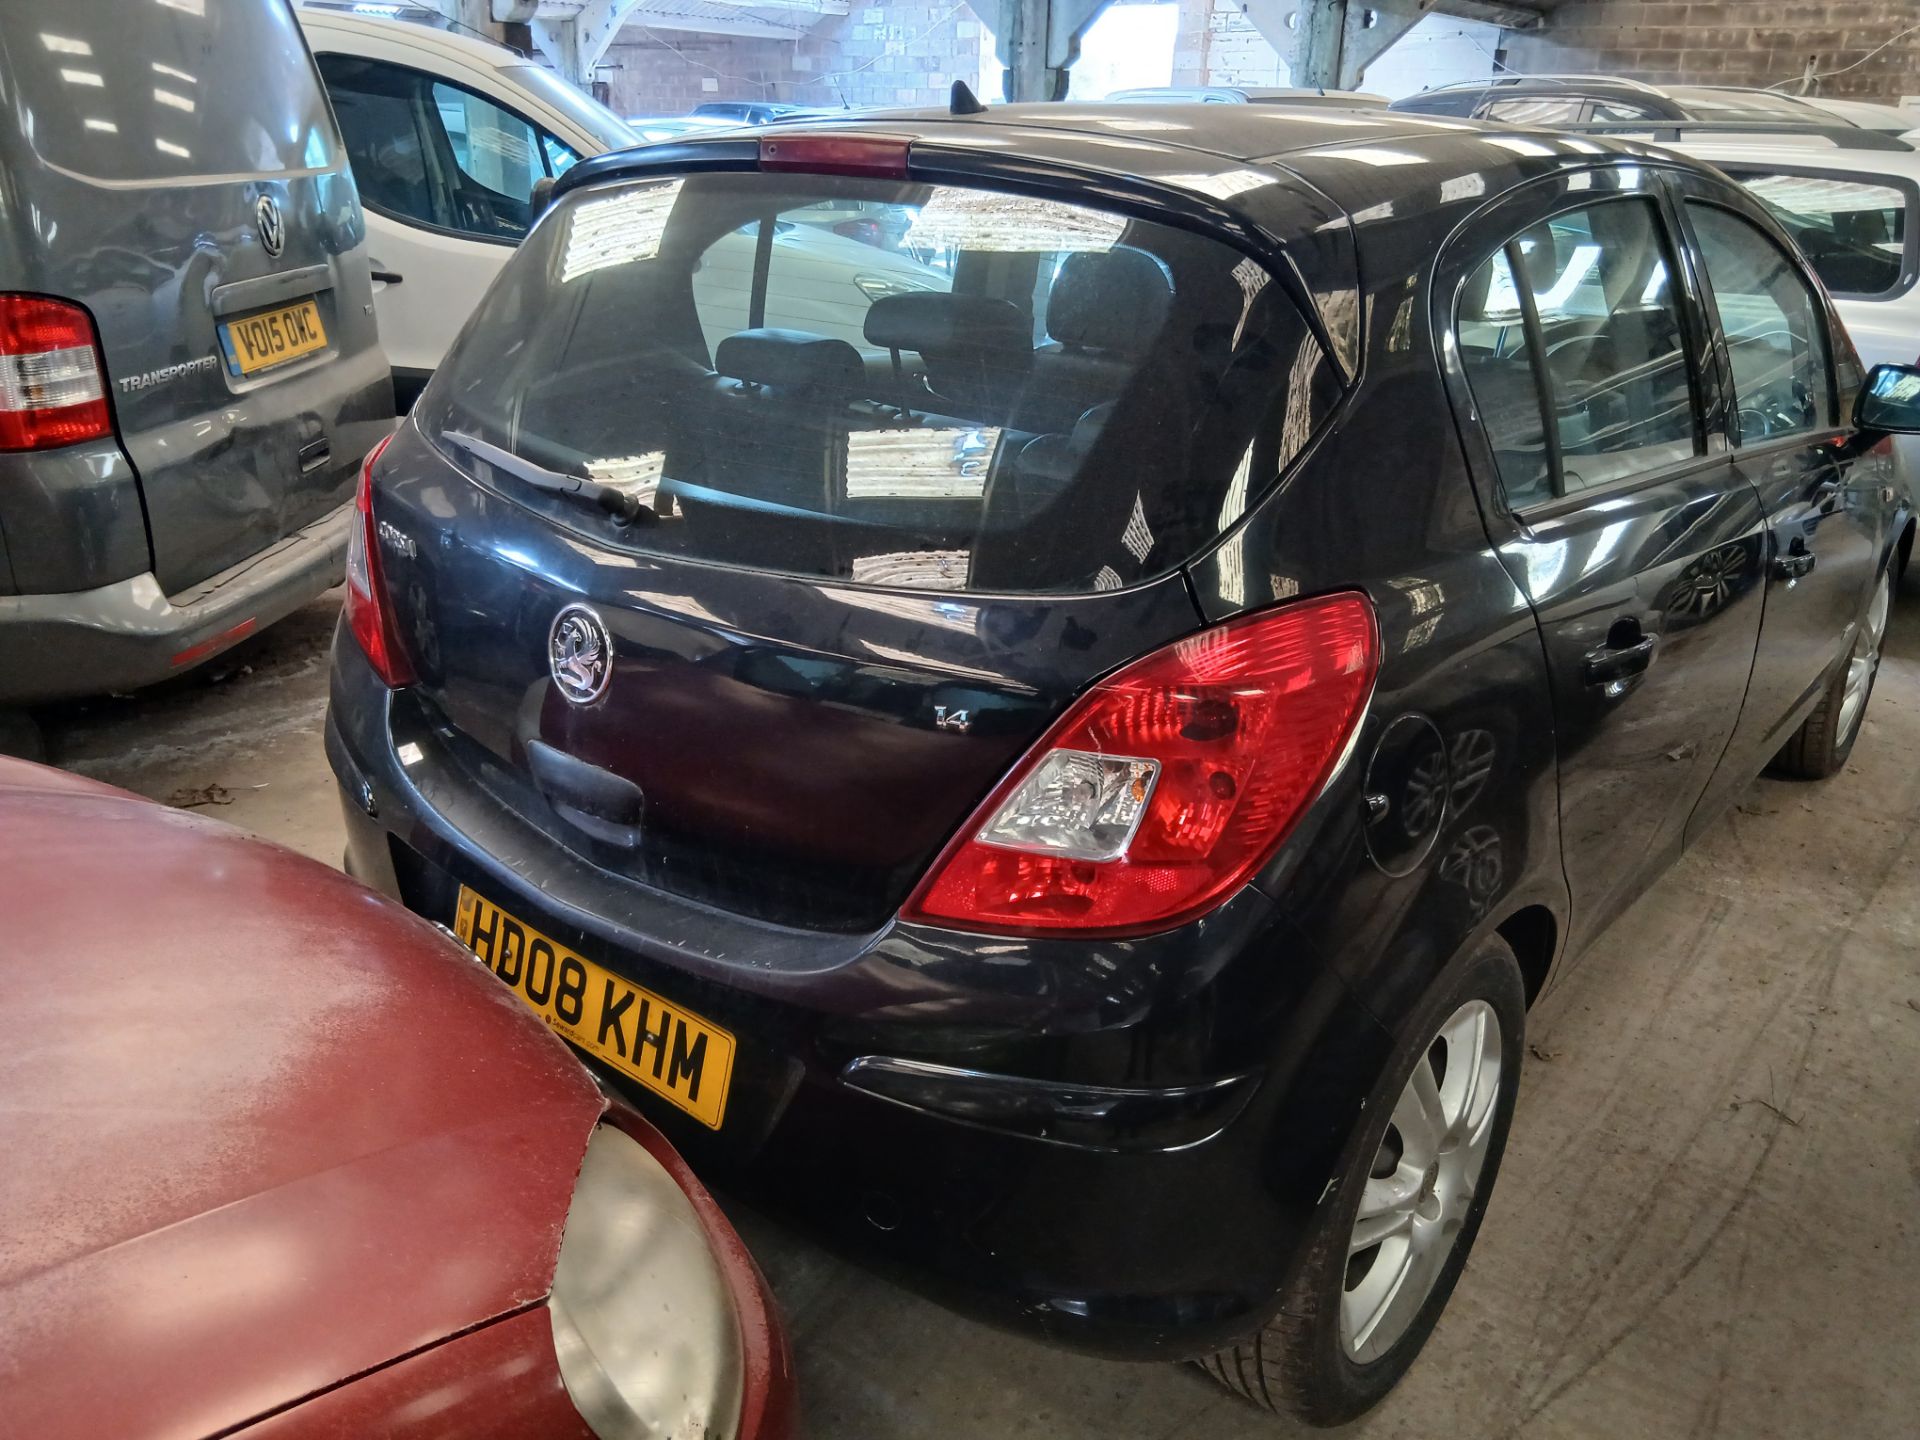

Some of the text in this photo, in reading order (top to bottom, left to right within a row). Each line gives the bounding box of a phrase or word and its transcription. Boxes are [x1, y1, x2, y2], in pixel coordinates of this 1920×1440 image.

[236, 316, 285, 361] VO15
[118, 355, 217, 392] TRANSPORTER
[470, 899, 708, 1102] HD08 KHM
